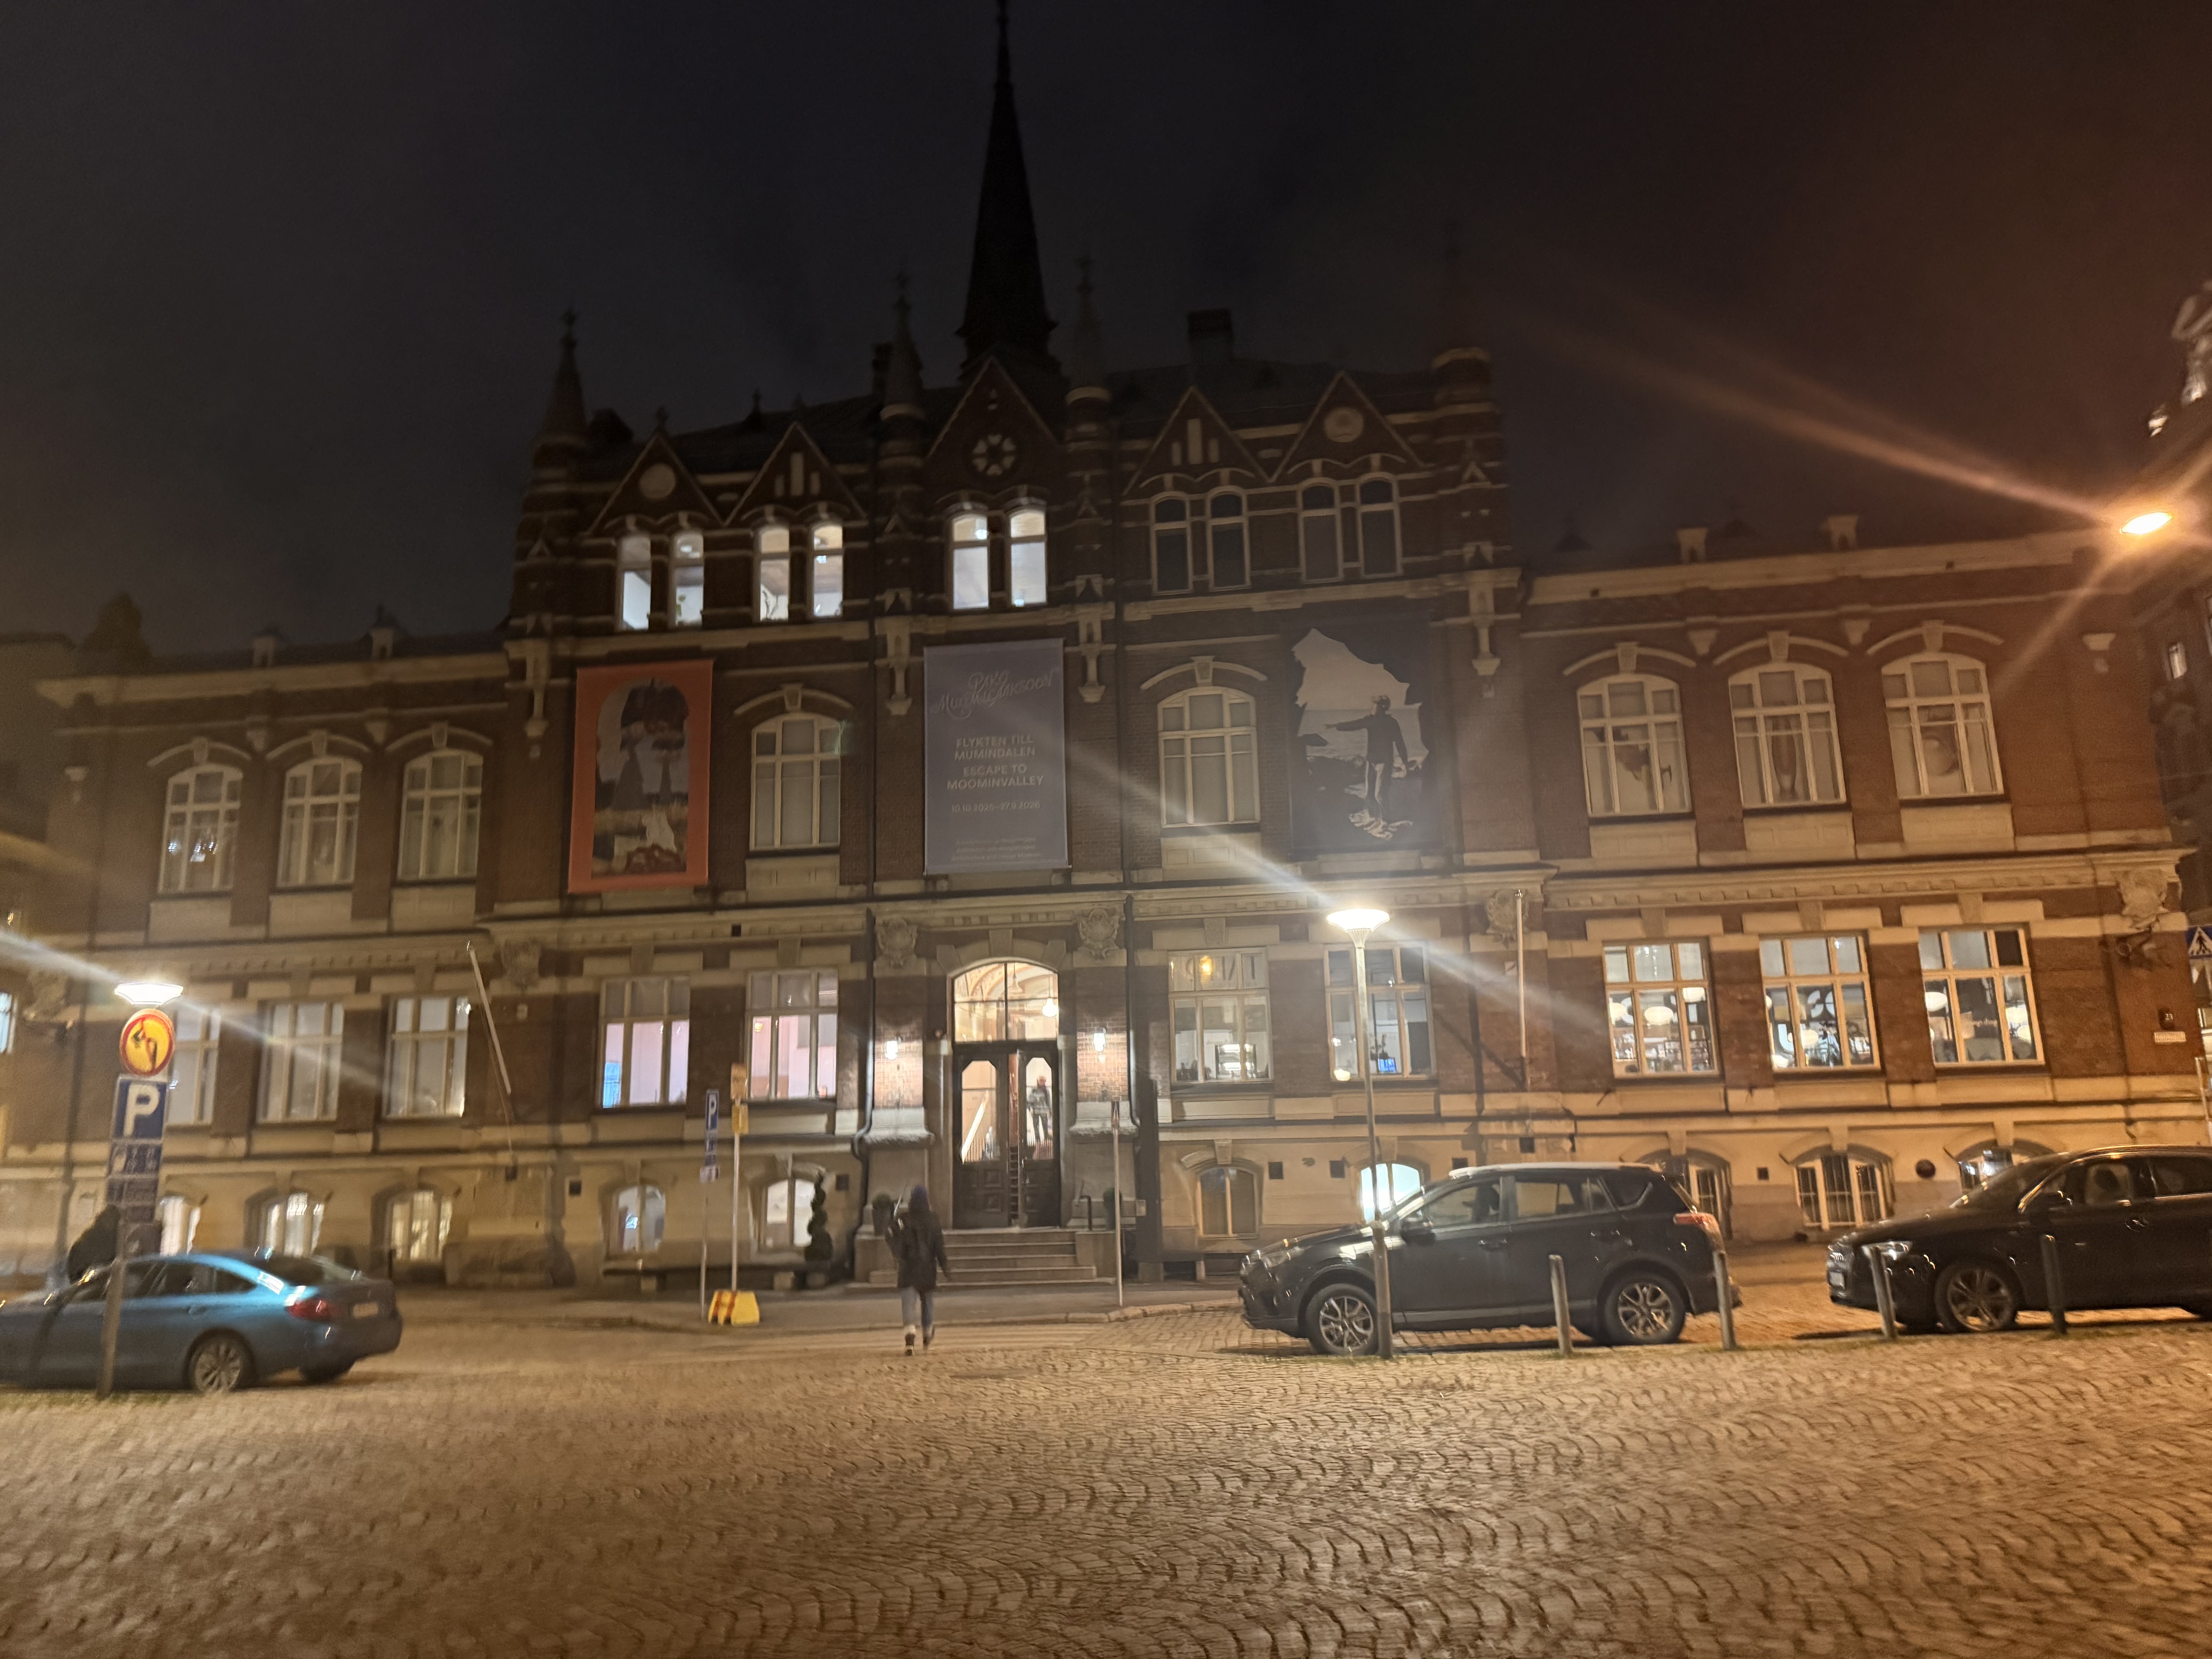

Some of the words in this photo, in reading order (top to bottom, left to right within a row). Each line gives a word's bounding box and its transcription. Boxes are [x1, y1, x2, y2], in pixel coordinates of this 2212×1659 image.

[956, 736, 1006, 748] FLYKTEN
[1012, 734, 1034, 745] TILL
[954, 746, 1036, 761] MUMINDALEN
[963, 765, 1008, 777] ESCAPE
[1011, 763, 1028, 774] TO
[947, 775, 1044, 790] MOOMINVALLEY
[123, 1083, 160, 1137] P
[708, 1094, 717, 1128] P
